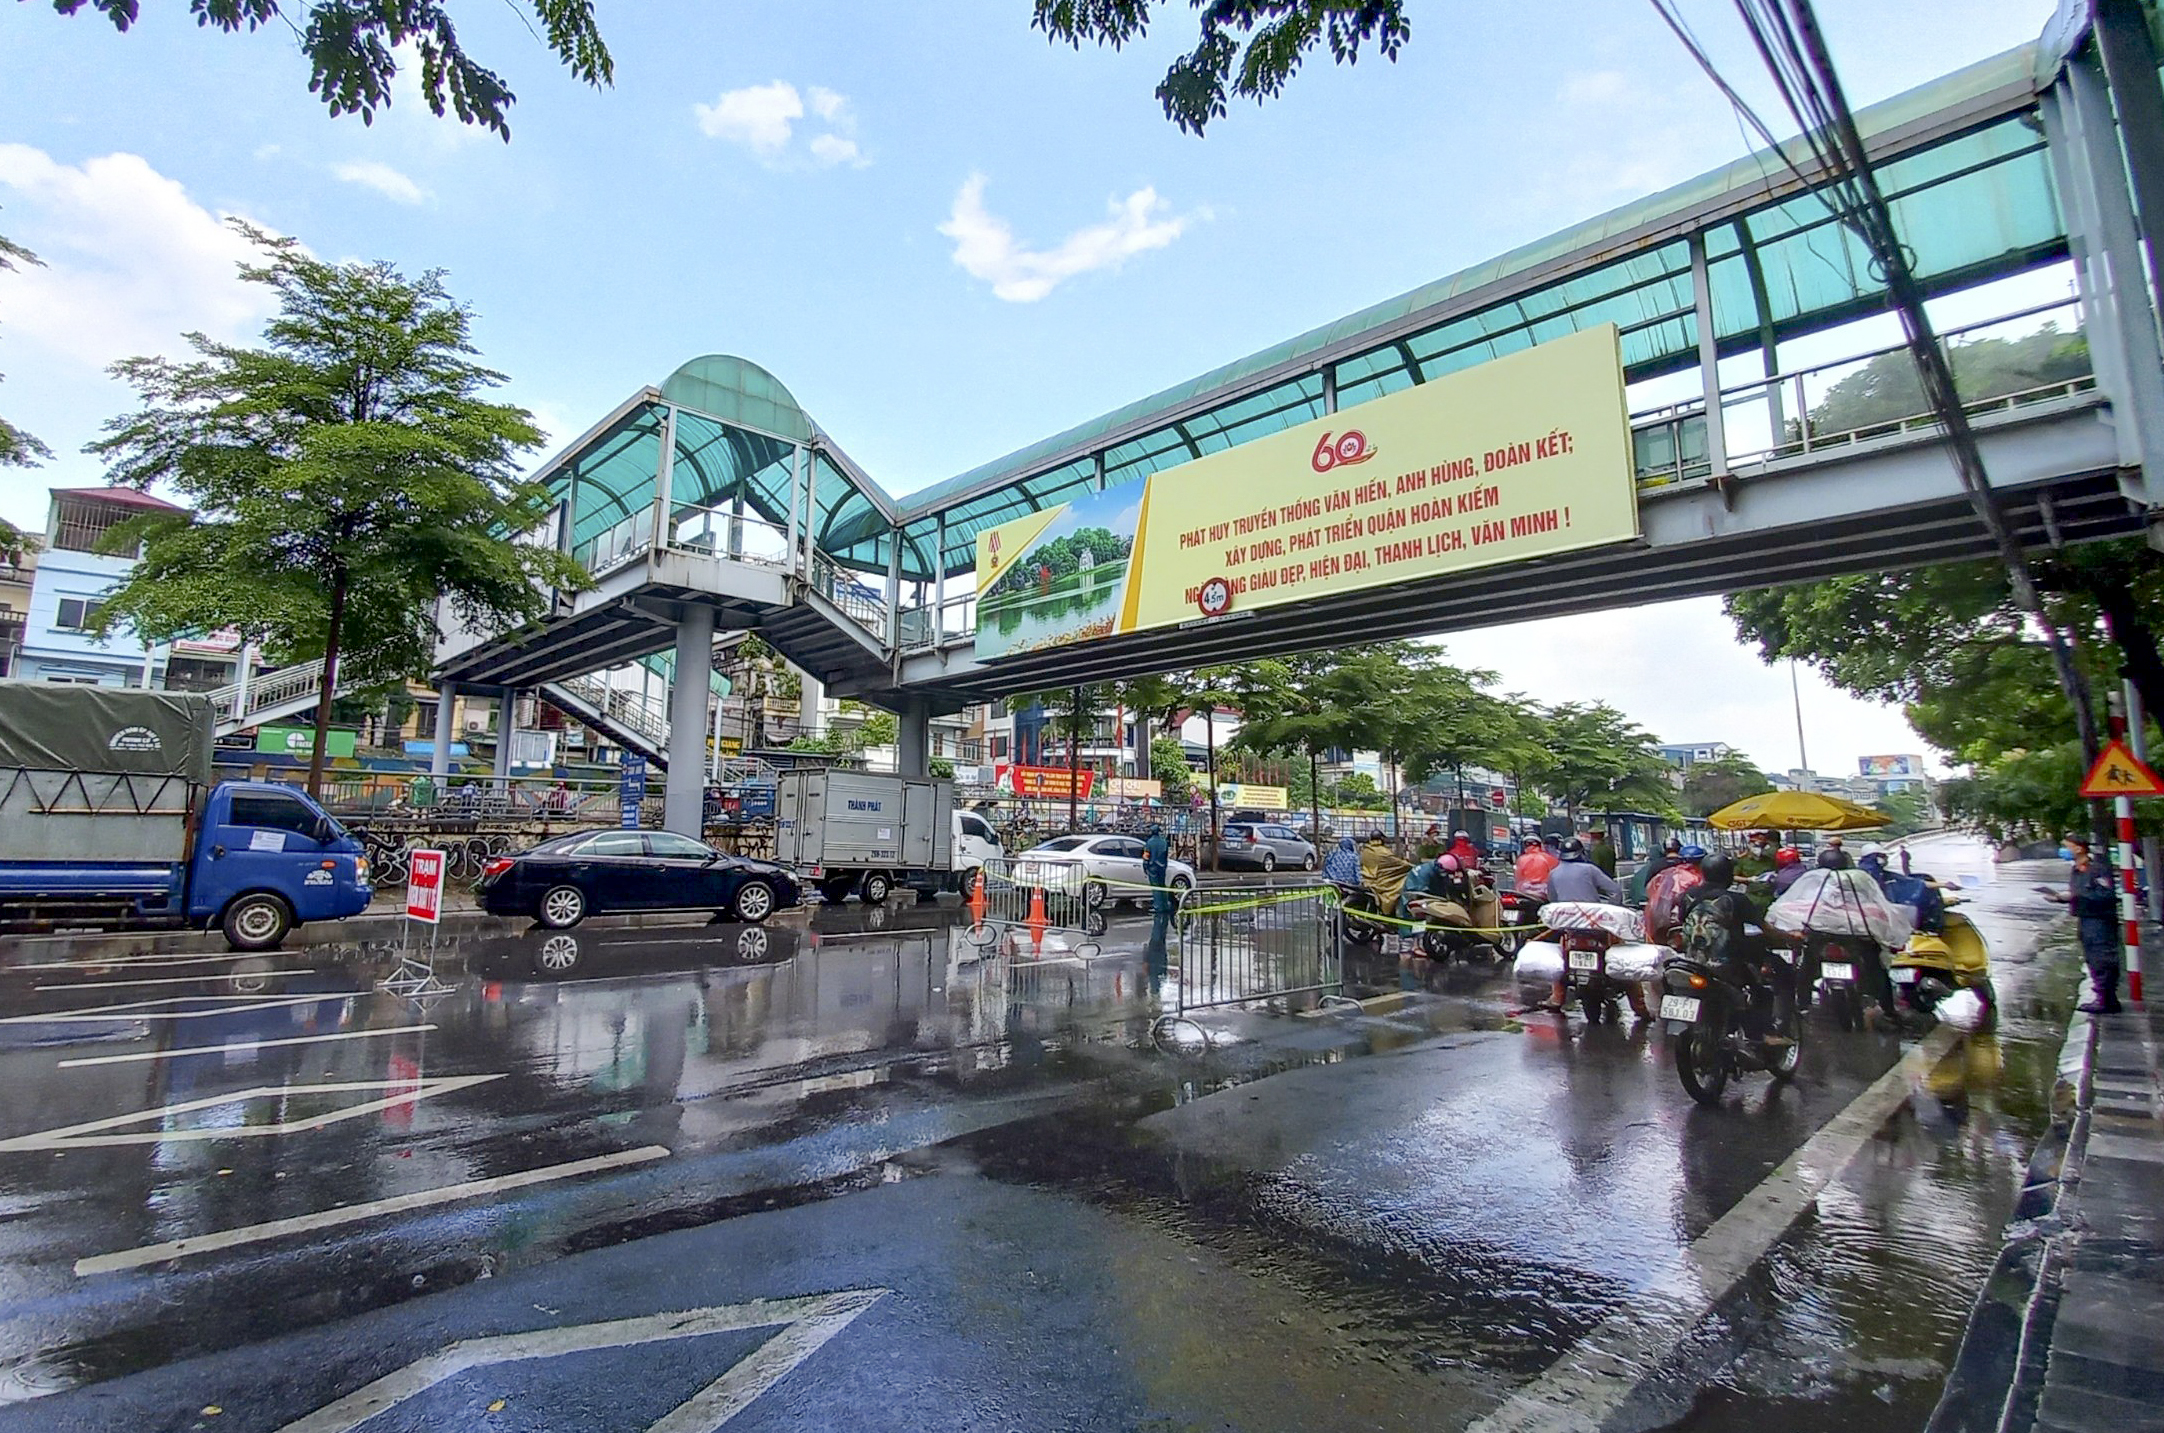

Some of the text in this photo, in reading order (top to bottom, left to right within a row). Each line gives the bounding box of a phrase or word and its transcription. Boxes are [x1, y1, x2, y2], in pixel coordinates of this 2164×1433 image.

[1180, 527, 1206, 550] PHÁT
[1209, 522, 1230, 543] HUY
[1280, 496, 1320, 526] THỐNG
[1324, 490, 1350, 513] VĂN
[1354, 476, 1392, 506] HIẾN,
[1396, 470, 1427, 495] ANH
[1431, 459, 1479, 487] HÙNG,
[1484, 442, 1531, 473] ĐOÀN
[1536, 427, 1574, 460] KẾT;
[1311, 429, 1366, 473] 60
[1225, 483, 1500, 567] XÂY DỰNG, PHÁT TRIỂN QUẬN HOÀN KIẾM
[1250, 568, 1277, 592] GIÀU
[1280, 564, 1306, 587] ĐẸP,
[1310, 554, 1340, 580] HIỆN
[1344, 550, 1371, 574] ĐẠI,
[1375, 538, 1423, 565] THANH
[1427, 530, 1467, 558] LỊCH,
[1471, 519, 1505, 545] VĂN
[1510, 509, 1558, 538] MINH
[414, 858, 437, 878] TRẠM
